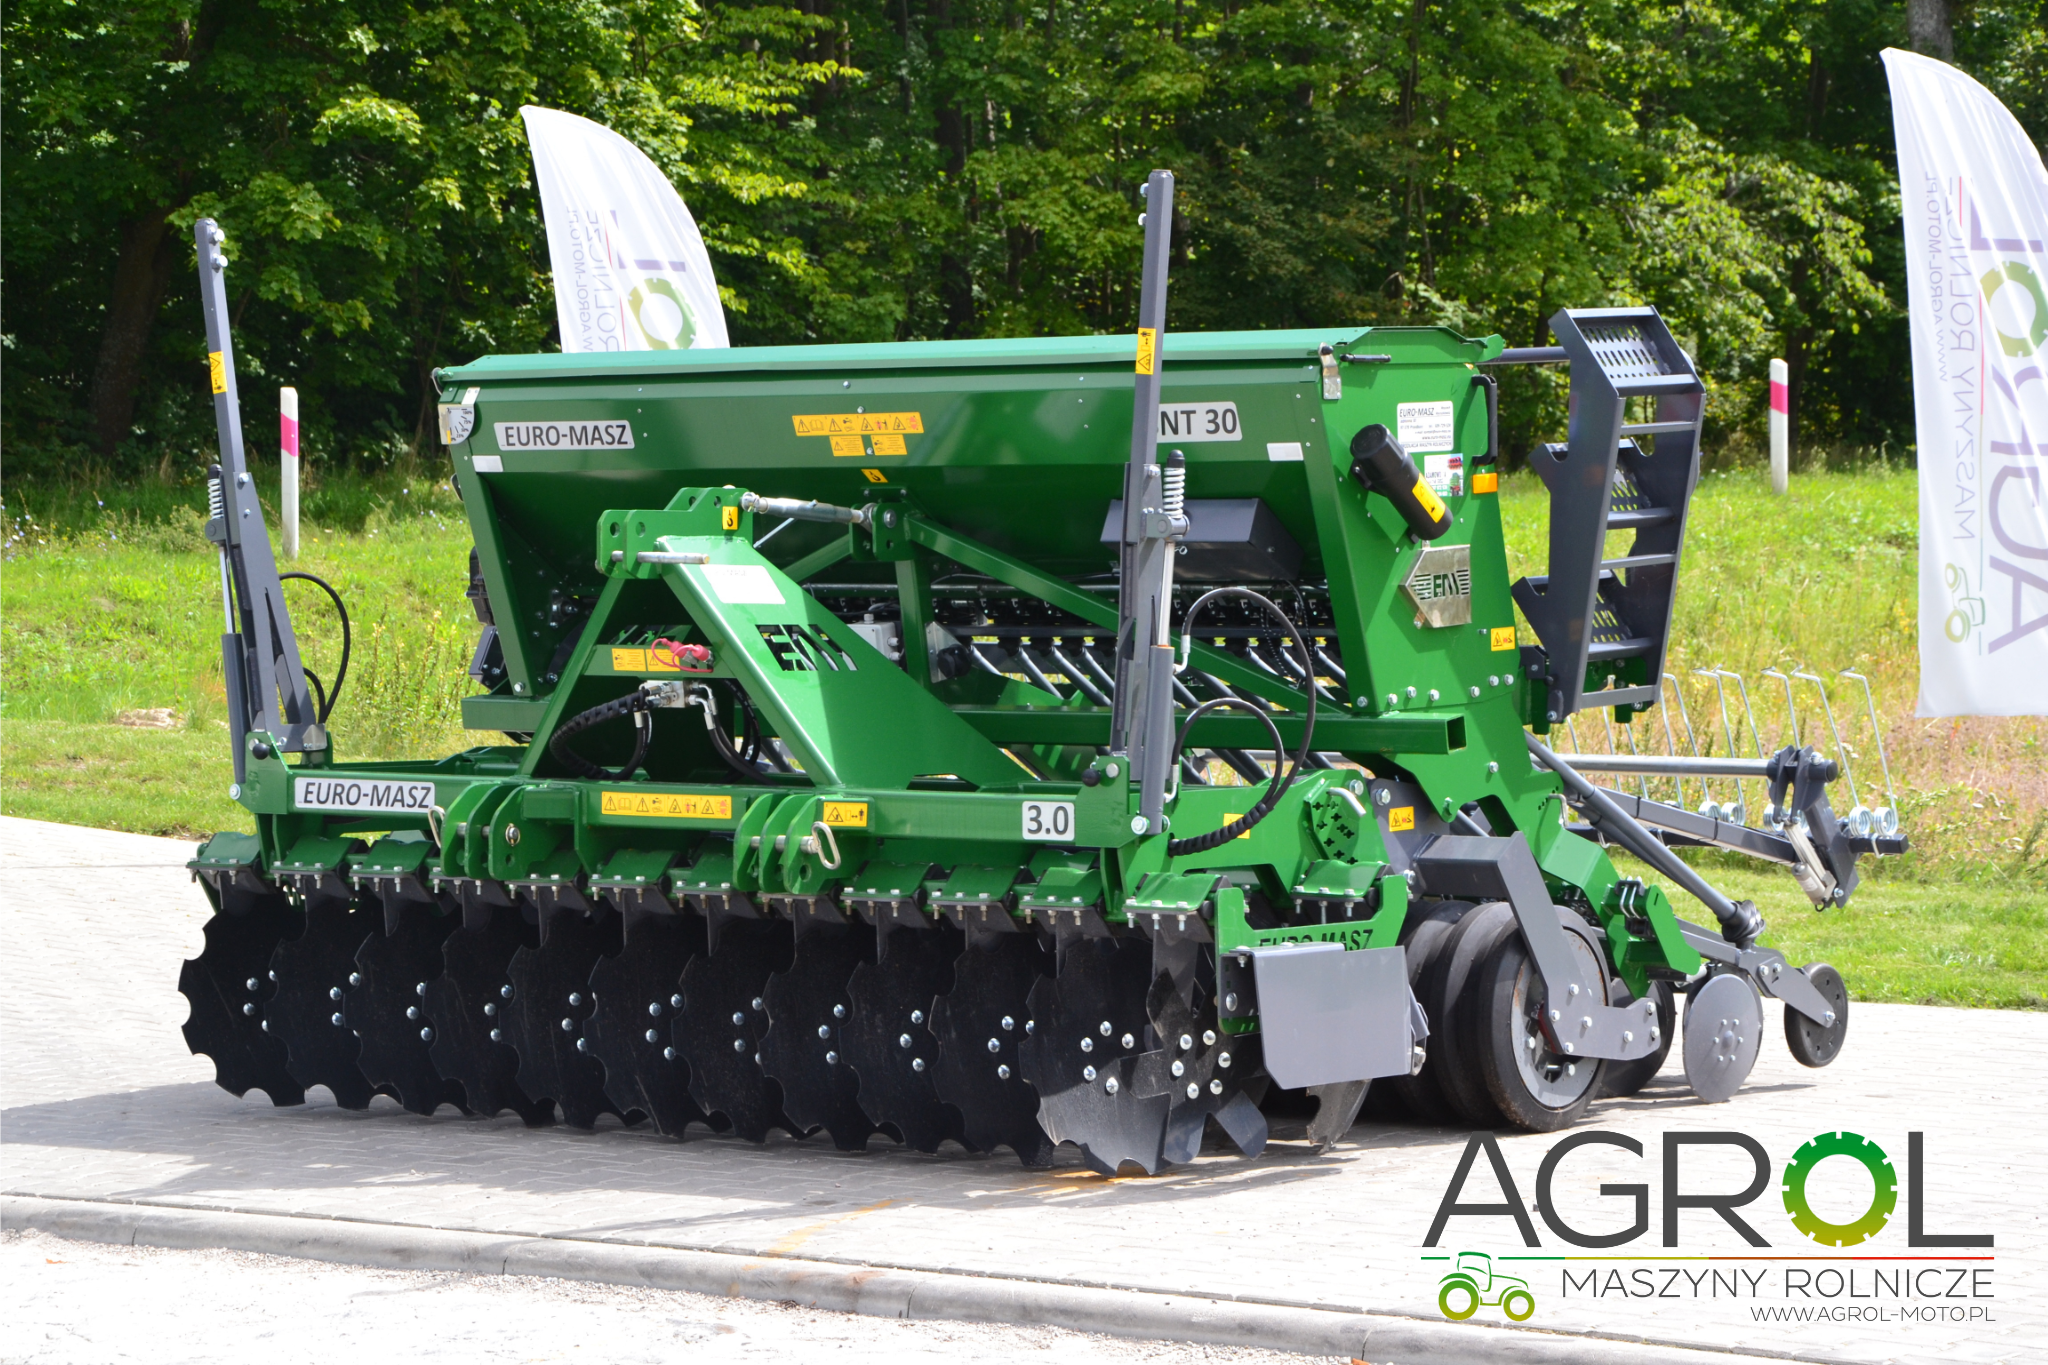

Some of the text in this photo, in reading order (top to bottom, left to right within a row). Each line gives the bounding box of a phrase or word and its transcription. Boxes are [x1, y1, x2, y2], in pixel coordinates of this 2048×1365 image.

[1205, 408, 1237, 434] 30
[504, 424, 628, 447] EURO-MASZ
[303, 781, 432, 809] EURO-MASZ
[1027, 804, 1069, 836] 3.0
